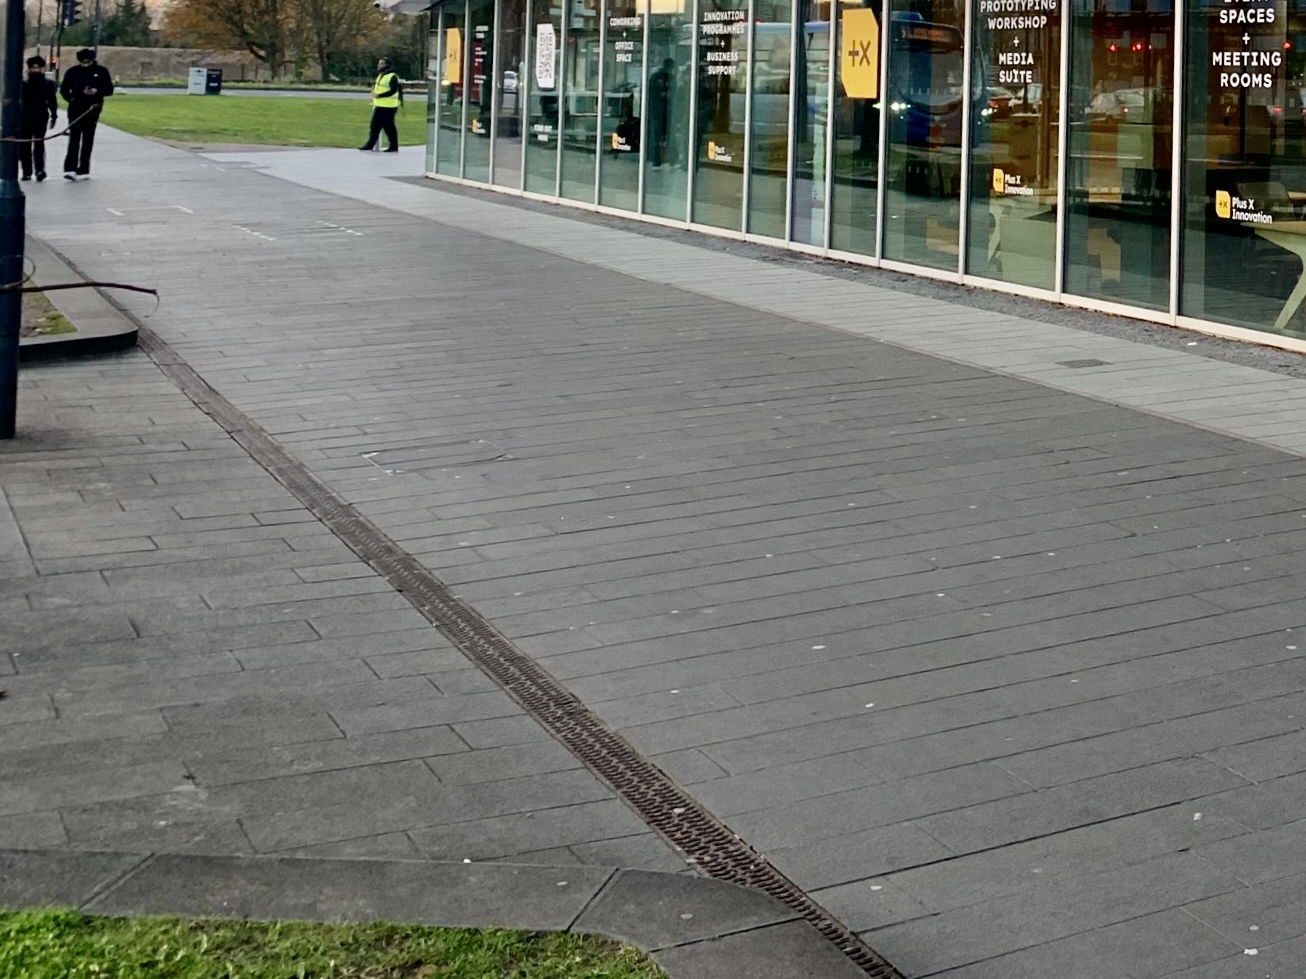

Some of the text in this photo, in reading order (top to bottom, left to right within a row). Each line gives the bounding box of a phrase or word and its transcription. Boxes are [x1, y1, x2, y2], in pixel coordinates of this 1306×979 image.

[703, 11, 745, 22] INNOVATION
[1219, 8, 1275, 24] SPACES
[702, 24, 745, 35] PROGRAMMES
[987, 16, 1047, 30] WORKSHOP
[615, 41, 634, 50] OFFICE
[616, 53, 632, 62] SPACE
[706, 52, 739, 61] BUSINESS
[998, 52, 1034, 65] MEDIA
[1212, 51, 1282, 67] MEETING
[707, 65, 737, 75] SUPPORT
[999, 70, 1032, 83] SUITE
[1220, 73, 1273, 88] ROOMS
[1232, 197, 1255, 210] Plus X
[1232, 208, 1273, 224] Innovation
